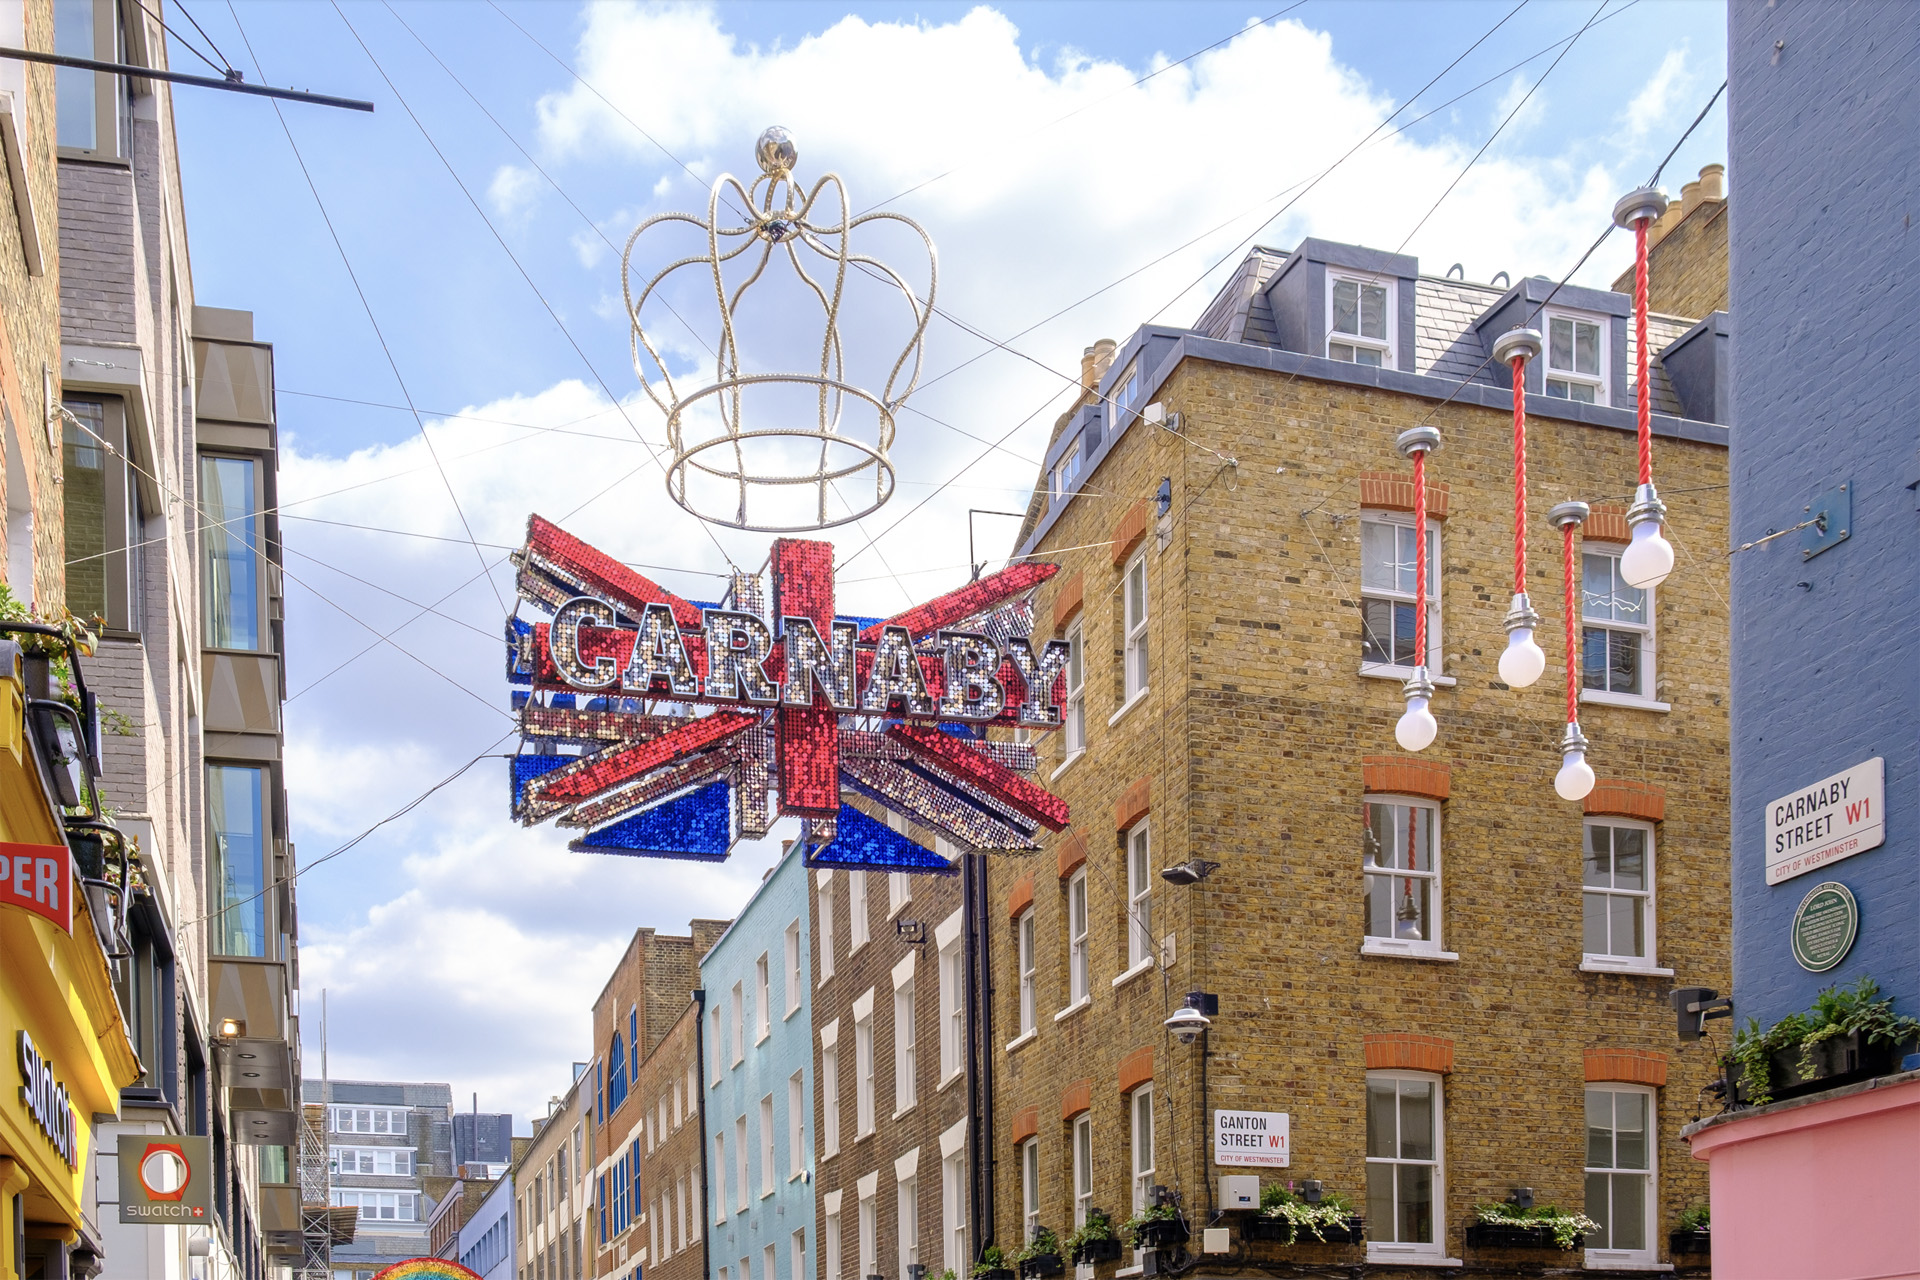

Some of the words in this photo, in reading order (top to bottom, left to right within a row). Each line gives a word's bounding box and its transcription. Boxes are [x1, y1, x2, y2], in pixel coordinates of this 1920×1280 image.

[549, 596, 1071, 728] CARNABY
[1775, 777, 1850, 827] CARNABY
[1775, 813, 1833, 853] STREET
[1845, 797, 1870, 825] W1
[1775, 863, 1791, 877] CITY
[1793, 860, 1802, 871] OF
[1804, 838, 1858, 866] WESTMINSTER
[1810, 902, 1824, 911] LORD
[17, 1030, 72, 1166] swatch
[1220, 1115, 1267, 1130] GANTON
[1221, 1133, 1263, 1147] STREET
[1269, 1135, 1285, 1148] W1
[126, 1203, 192, 1217] swatch
